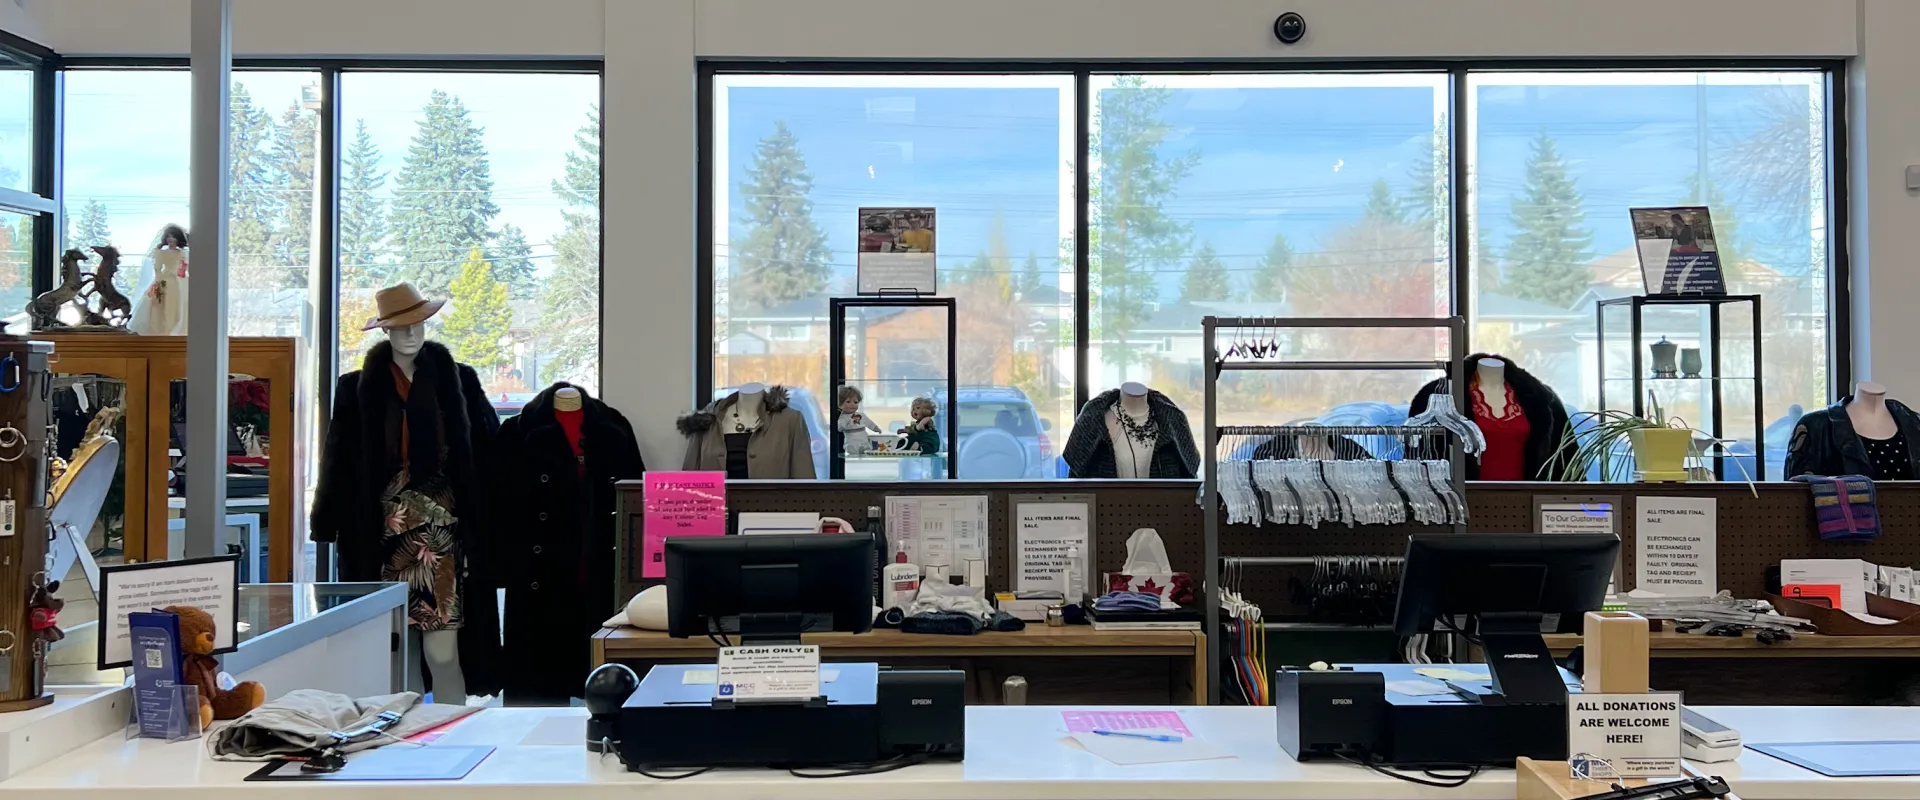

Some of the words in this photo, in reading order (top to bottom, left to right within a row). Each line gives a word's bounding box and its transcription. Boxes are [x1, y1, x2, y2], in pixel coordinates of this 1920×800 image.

[150, 588, 180, 596] Sometimes
[1576, 702, 1599, 710] ALL
[1604, 702, 1676, 710] DONATIONS
[1580, 718, 1604, 727] ARE
[1608, 718, 1669, 727] WELCOME
[1607, 735, 1643, 743] HERE!
